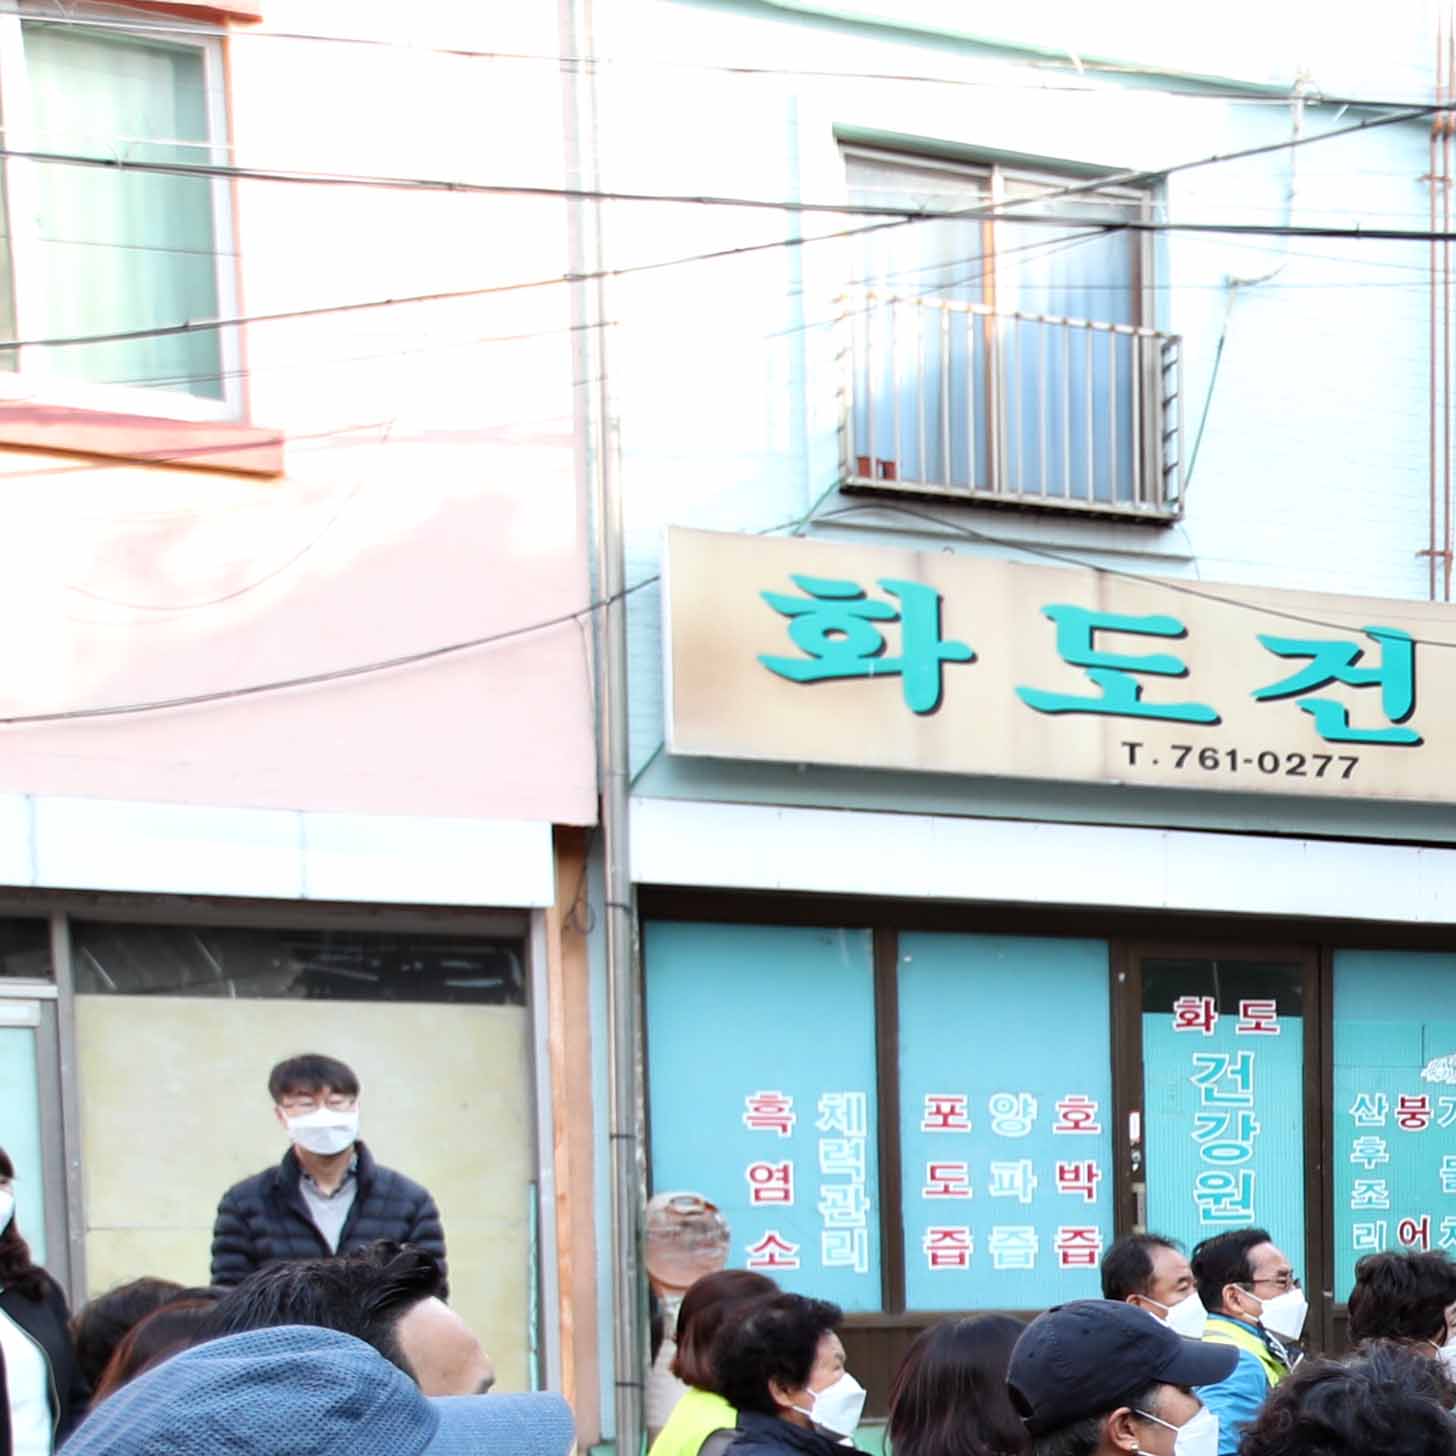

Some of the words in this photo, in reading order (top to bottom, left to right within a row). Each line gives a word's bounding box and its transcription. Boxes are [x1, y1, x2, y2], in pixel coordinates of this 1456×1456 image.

[742, 1091, 800, 1271] 흑염소
[922, 1093, 974, 1270] 포도즙
[987, 1091, 1039, 1270] 양파즙
[1053, 1094, 1103, 1270] 호박즙
[1190, 1050, 1261, 1225] 건강원
[1349, 1093, 1390, 1252] 산후조리
